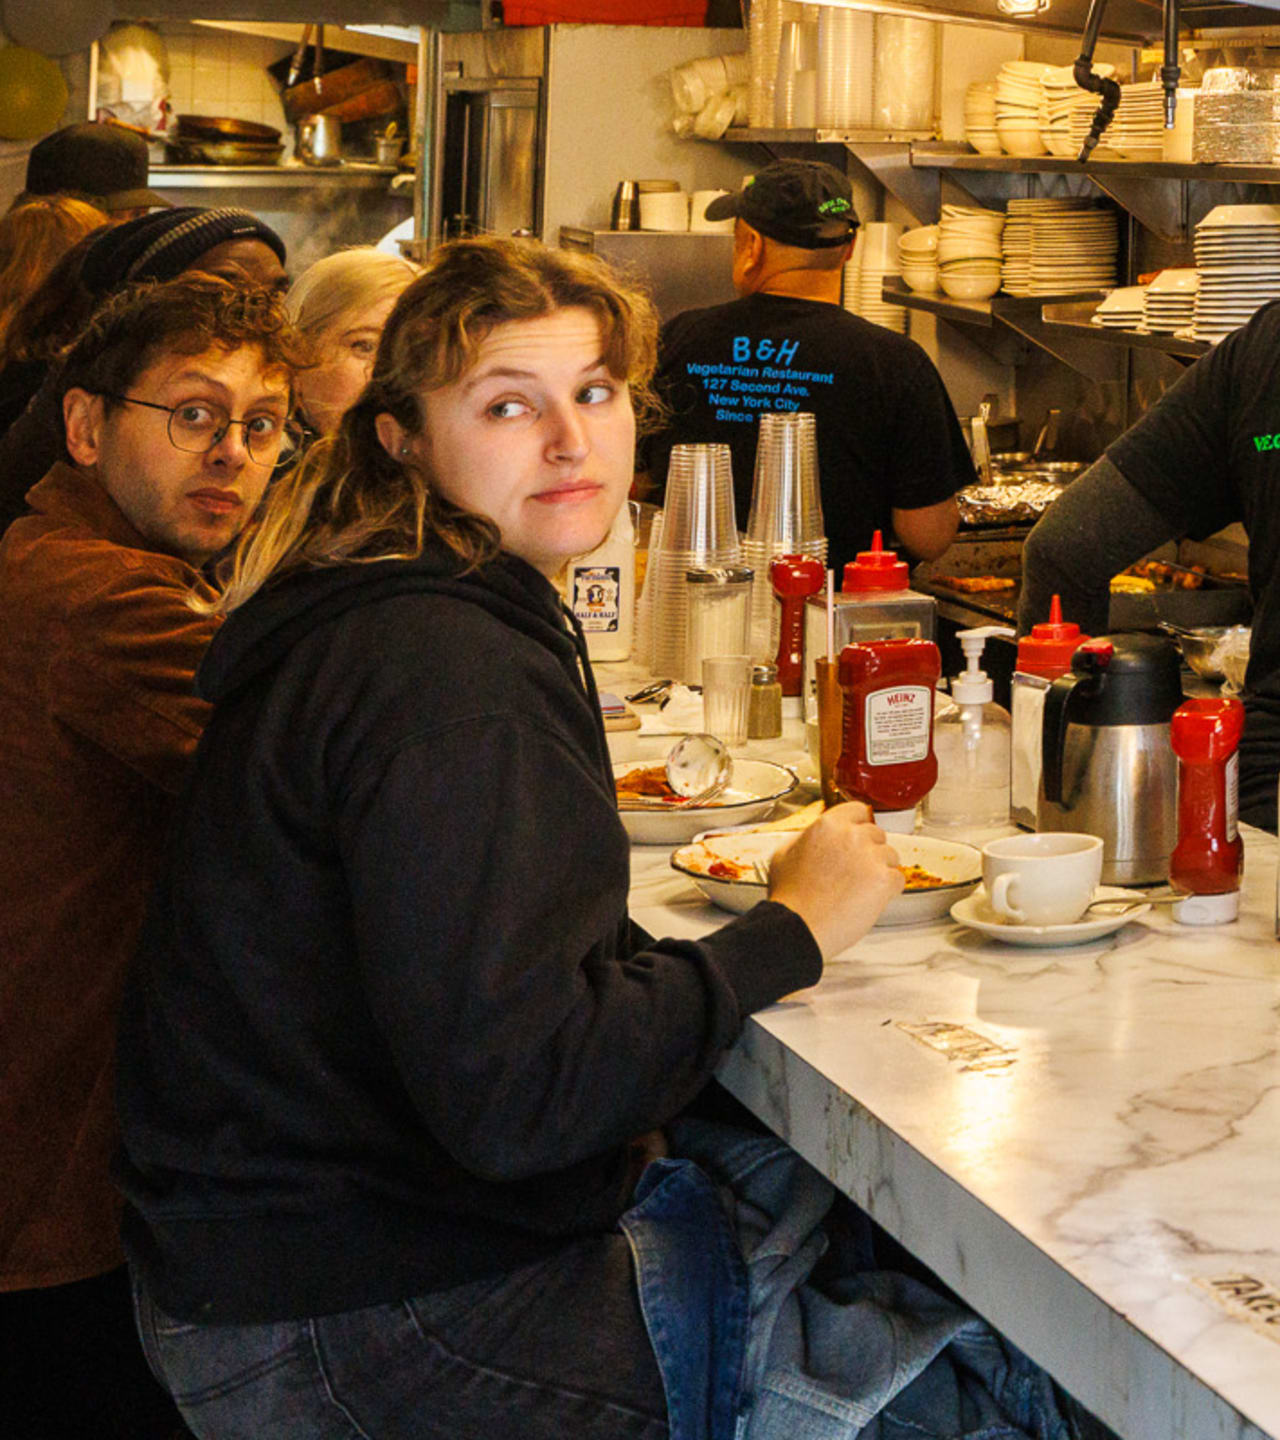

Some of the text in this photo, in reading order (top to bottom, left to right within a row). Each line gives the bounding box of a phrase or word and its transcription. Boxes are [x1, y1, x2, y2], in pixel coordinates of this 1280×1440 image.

[733, 336, 800, 367] B & H
[686, 362, 834, 385] Vegetarian Restaurant
[702, 378, 811, 398] 127 Second Ave.
[708, 393, 801, 413] New York City
[715, 409, 754, 423] Since
[886, 693, 916, 706] HEINZ
